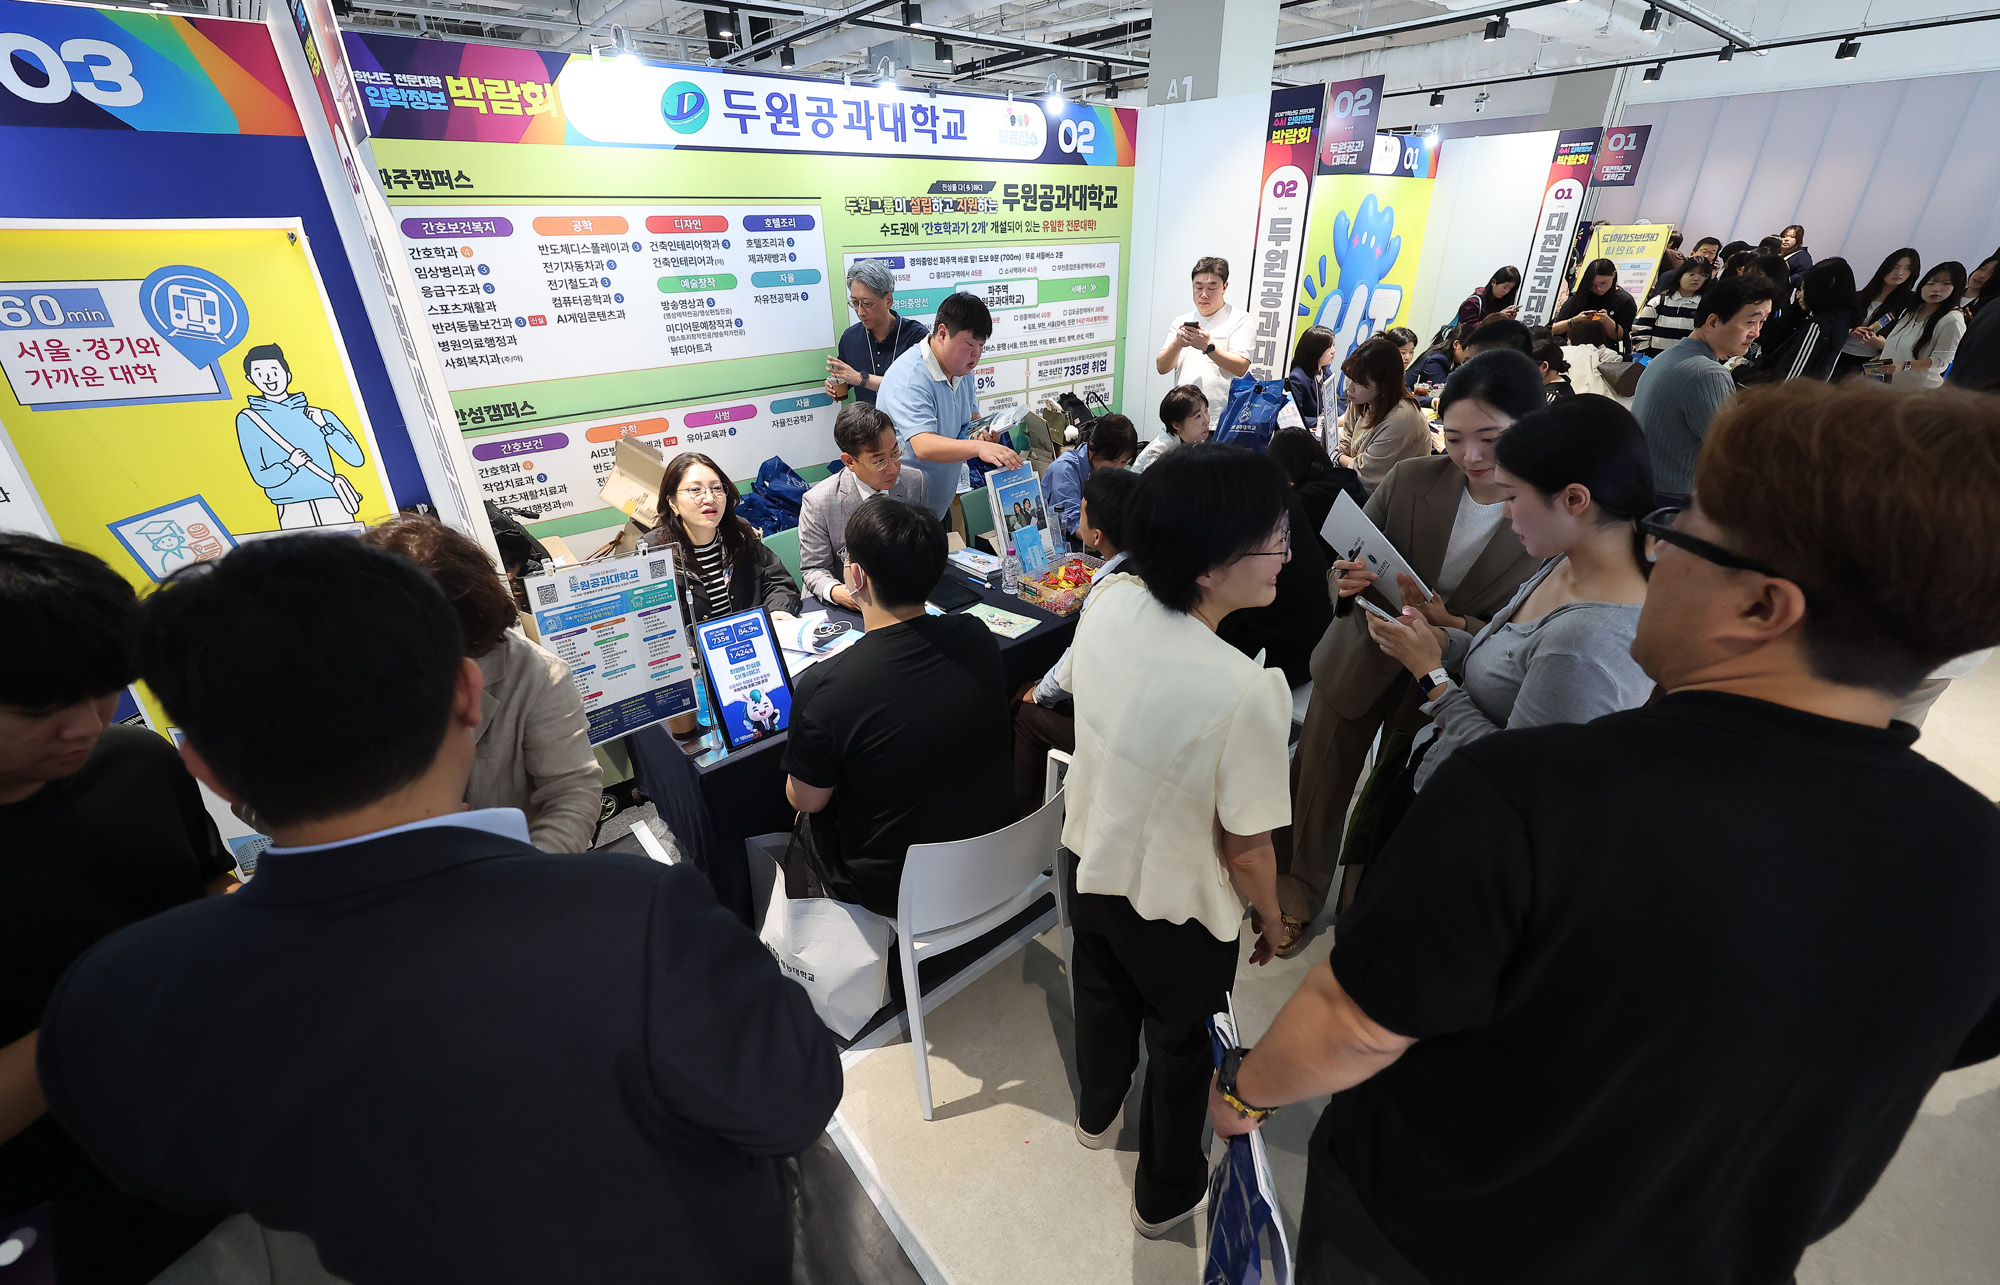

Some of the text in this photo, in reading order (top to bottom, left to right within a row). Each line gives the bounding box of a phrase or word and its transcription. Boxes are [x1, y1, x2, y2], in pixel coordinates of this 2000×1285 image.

[0, 32, 144, 107] 03
[353, 69, 442, 89] 학년도 전문대학
[1166, 75, 1193, 102] A1
[364, 86, 449, 110] 입학정보
[445, 76, 559, 117] 박람회
[1334, 87, 1374, 118] 02
[722, 88, 967, 144] 두원공과대학교
[1273, 114, 1314, 126] 수시 입학정보
[1058, 119, 1095, 154] 02
[1272, 126, 1312, 146] 박람회
[1608, 132, 1637, 152] 01
[1329, 140, 1364, 154] 두원공과
[1331, 154, 1357, 166] 대학교
[1404, 147, 1420, 170] 01
[1556, 154, 1590, 166] 박람회
[1273, 180, 1298, 198] 02
[1554, 188, 1573, 200] 01
[845, 183, 1118, 215] 두원그룹이 설립하고 지원하는 두원공과대학교
[421, 220, 496, 235] 간호보건복지
[572, 219, 593, 232] 공학
[674, 218, 702, 231] 디자인
[764, 217, 797, 229] 호텔조리
[880, 222, 919, 236] 수도권에
[990, 221, 1023, 234] 개설되어
[1025, 220, 1040, 233] 있는
[1042, 220, 1064, 232] 유일한
[1066, 219, 1097, 232] 전문대학!
[538, 241, 630, 256] 반도체디스플레이과
[650, 239, 720, 252] 건축인테리어학과
[746, 238, 785, 248] 호텔조리과
[408, 246, 458, 260] 간호학과
[748, 253, 787, 263] 제과제빵과
[910, 257, 938, 266] 경의중앙선
[940, 257, 957, 265] 파주역
[958, 256, 969, 264] 바로
[1000, 253, 1021, 261] (700m)
[414, 264, 475, 279] 임상병리과
[542, 260, 604, 274] 전기자동차과
[970, 269, 983, 277] 45분
[547, 276, 598, 291] 전기철도과
[680, 277, 716, 289] 예술창작
[779, 273, 796, 284] 자율
[421, 283, 480, 298] 응급구조과
[988, 284, 1009, 295] 파주역
[1071, 284, 1087, 293] 서해선
[427, 300, 497, 316] 스포츠재활과
[551, 293, 612, 308] 컴퓨터공학과
[661, 298, 704, 310] 방송영상과
[893, 297, 929, 310] 경의중앙선
[982, 294, 1025, 307] 원공과대학교)
[556, 309, 626, 324] AI게임콘텐츠과
[432, 317, 513, 334] 반려동물보건과
[530, 316, 545, 326] 신설
[666, 319, 733, 333] 미디어문예창작과
[438, 335, 518, 352] 병원의료행정과
[670, 343, 712, 356] 뷰티아트과
[1064, 362, 1090, 377] 735명
[1092, 359, 1107, 373] 취업
[25, 362, 158, 390] 가까운 대학
[795, 398, 810, 408] 자율
[455, 401, 537, 426] 안성캠퍼스
[714, 410, 730, 421] 사범
[771, 413, 814, 428] 자율전공학과
[619, 424, 638, 436] 공학
[687, 429, 727, 443] 유아교육과
[500, 439, 544, 455] 간호보건
[478, 462, 520, 479] 간호학과
[482, 476, 534, 493] 작업치료과
[569, 568, 639, 594] 두원공과대학교
